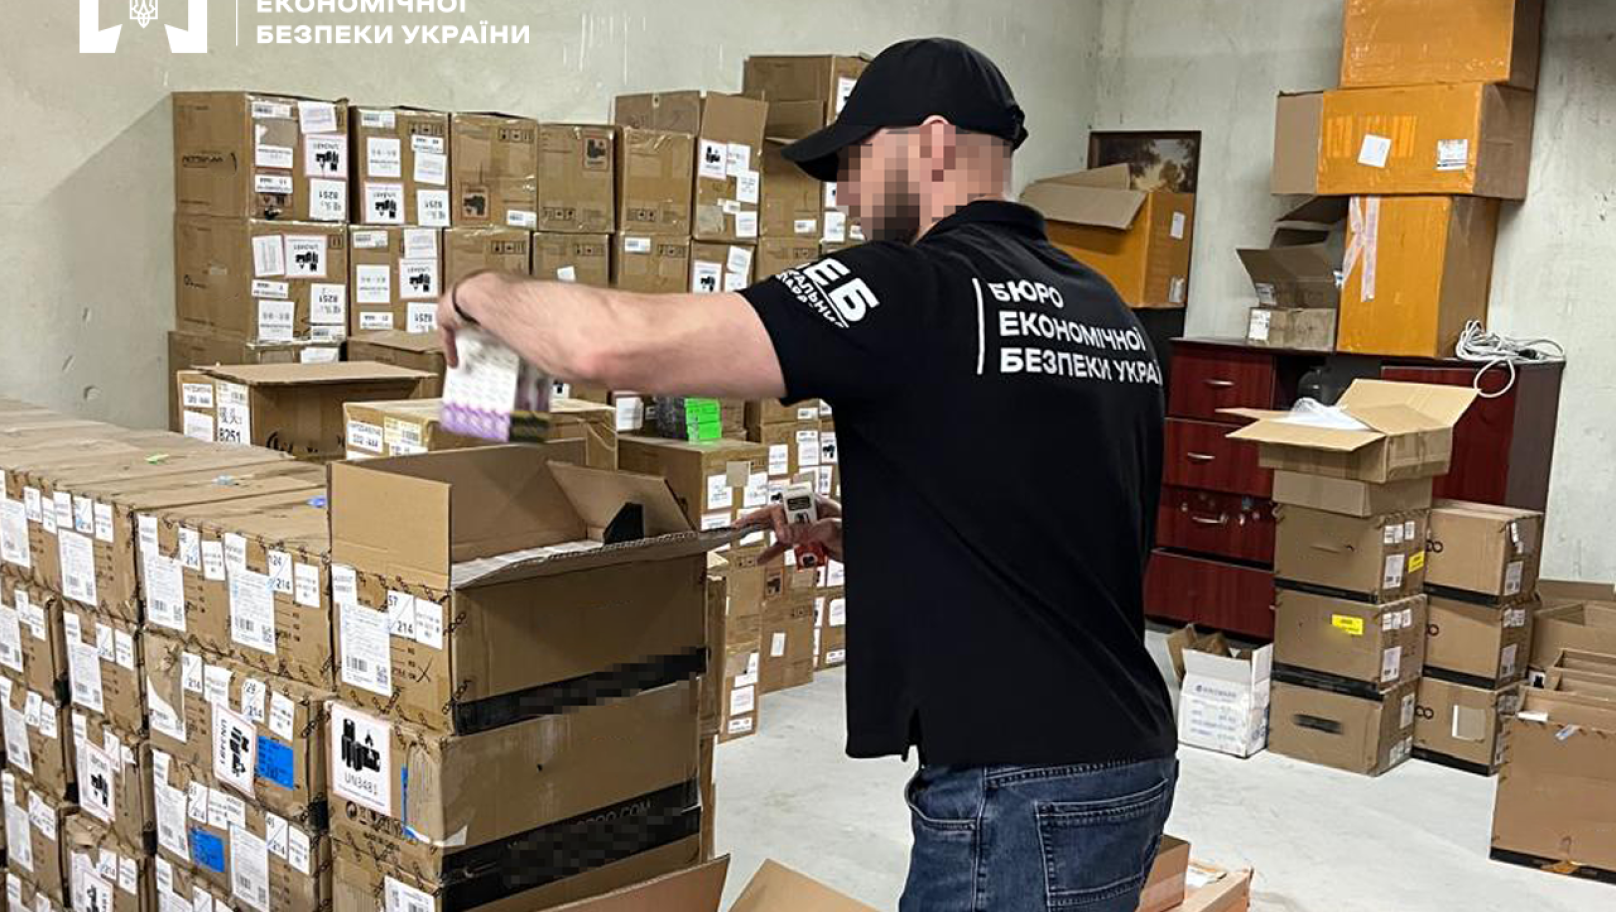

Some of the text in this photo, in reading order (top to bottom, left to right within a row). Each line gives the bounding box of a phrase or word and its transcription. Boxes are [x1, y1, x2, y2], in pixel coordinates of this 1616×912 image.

[796, 258, 880, 322] ЕБ
[987, 279, 1064, 308] БЮРО
[999, 311, 1146, 351] ЕКОНОМІЧНОЇ
[1000, 348, 1112, 381] БЕЗПЕКИ
[219, 427, 241, 443] 8251
[275, 577, 291, 591] 214
[397, 620, 414, 635] 214
[344, 771, 378, 796] UN3481
